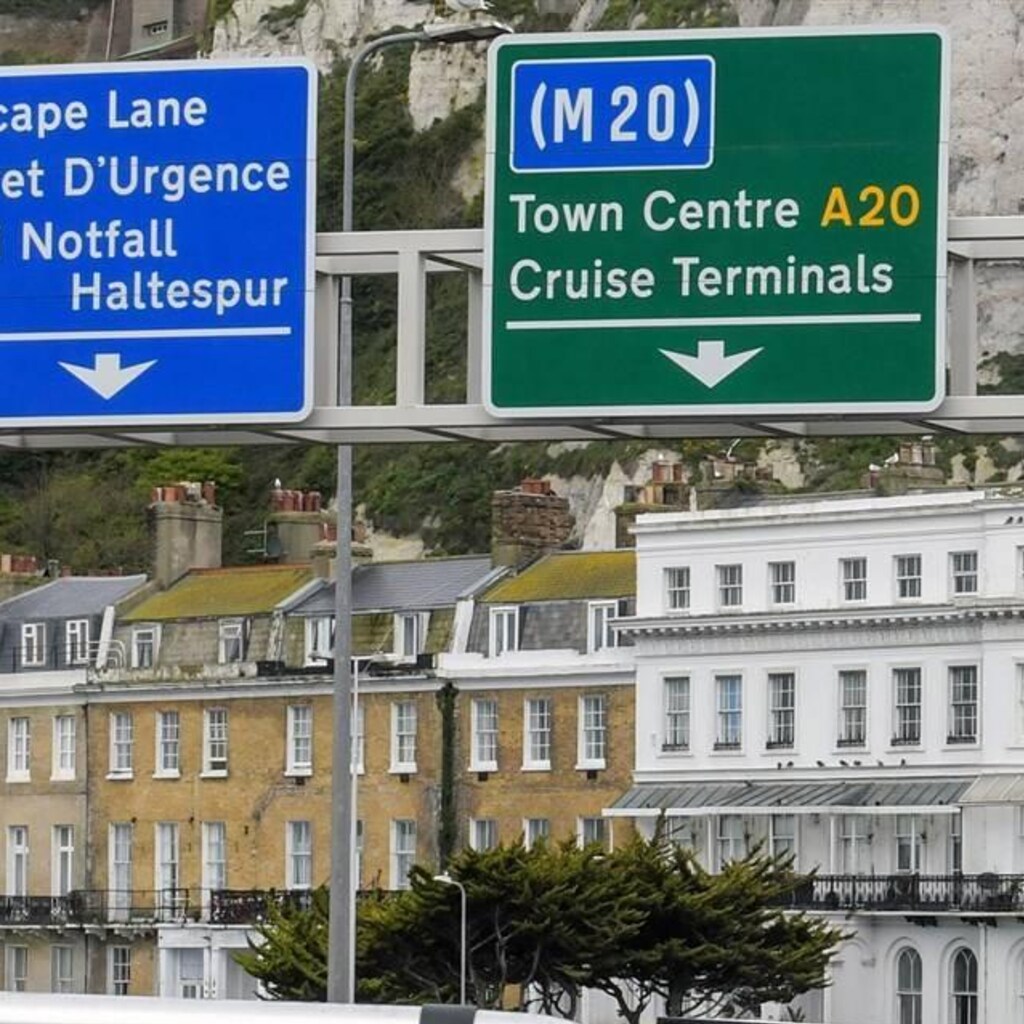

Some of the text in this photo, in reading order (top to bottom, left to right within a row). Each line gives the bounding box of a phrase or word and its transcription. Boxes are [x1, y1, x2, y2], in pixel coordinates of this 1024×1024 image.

[108, 89, 208, 129] Lane
[64, 155, 290, 202] D'Urgence
[509, 184, 920, 234] Town Centre A20
[22, 217, 178, 261] Notfall
[71, 270, 288, 315] Haltespur
[509, 254, 894, 300] Cruise Terminals
